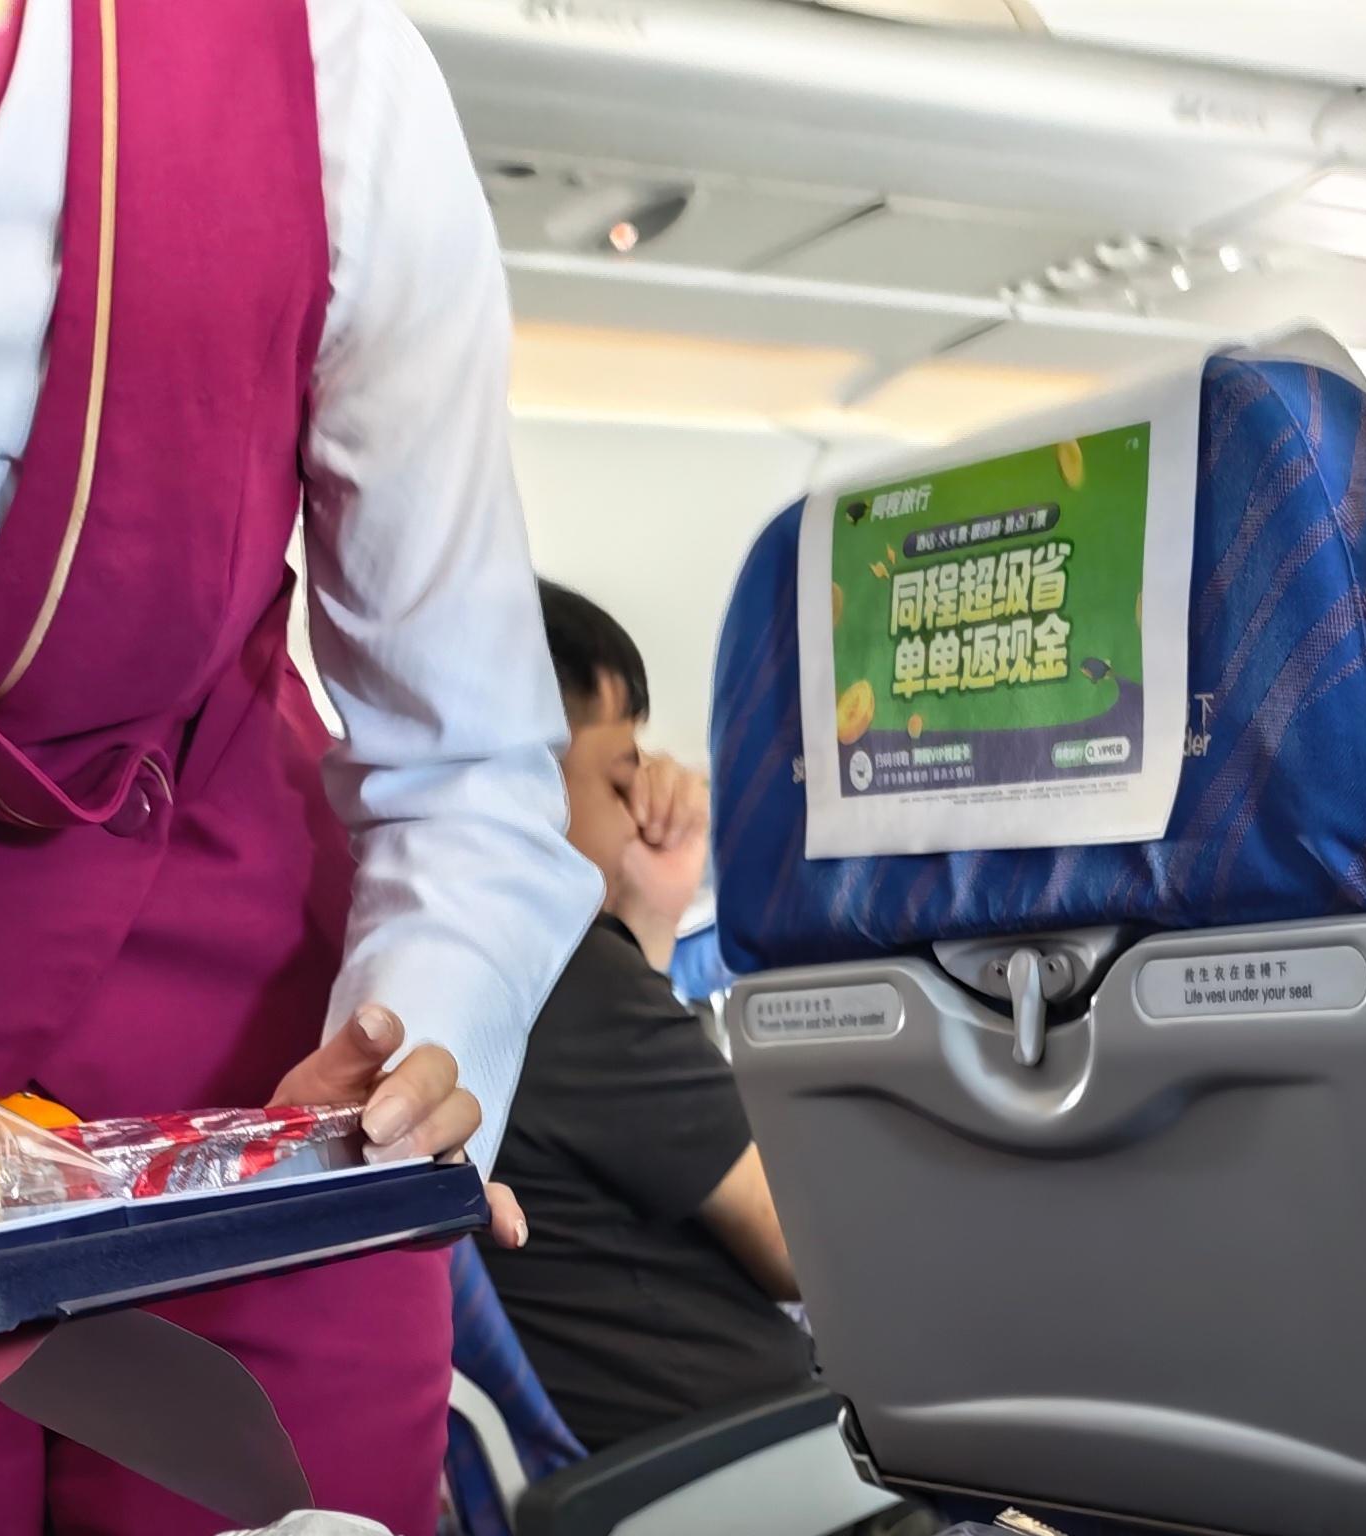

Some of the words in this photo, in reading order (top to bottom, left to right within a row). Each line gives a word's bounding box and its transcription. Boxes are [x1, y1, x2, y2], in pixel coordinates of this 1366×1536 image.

[891, 541, 1072, 637] 同程超级省
[892, 612, 1072, 699] 单单返现金
[1184, 988, 1203, 1005] Life
[1204, 988, 1227, 1004] vest
[1229, 985, 1260, 1003] under
[1261, 985, 1286, 1005] your
[1289, 983, 1313, 1000] seat
